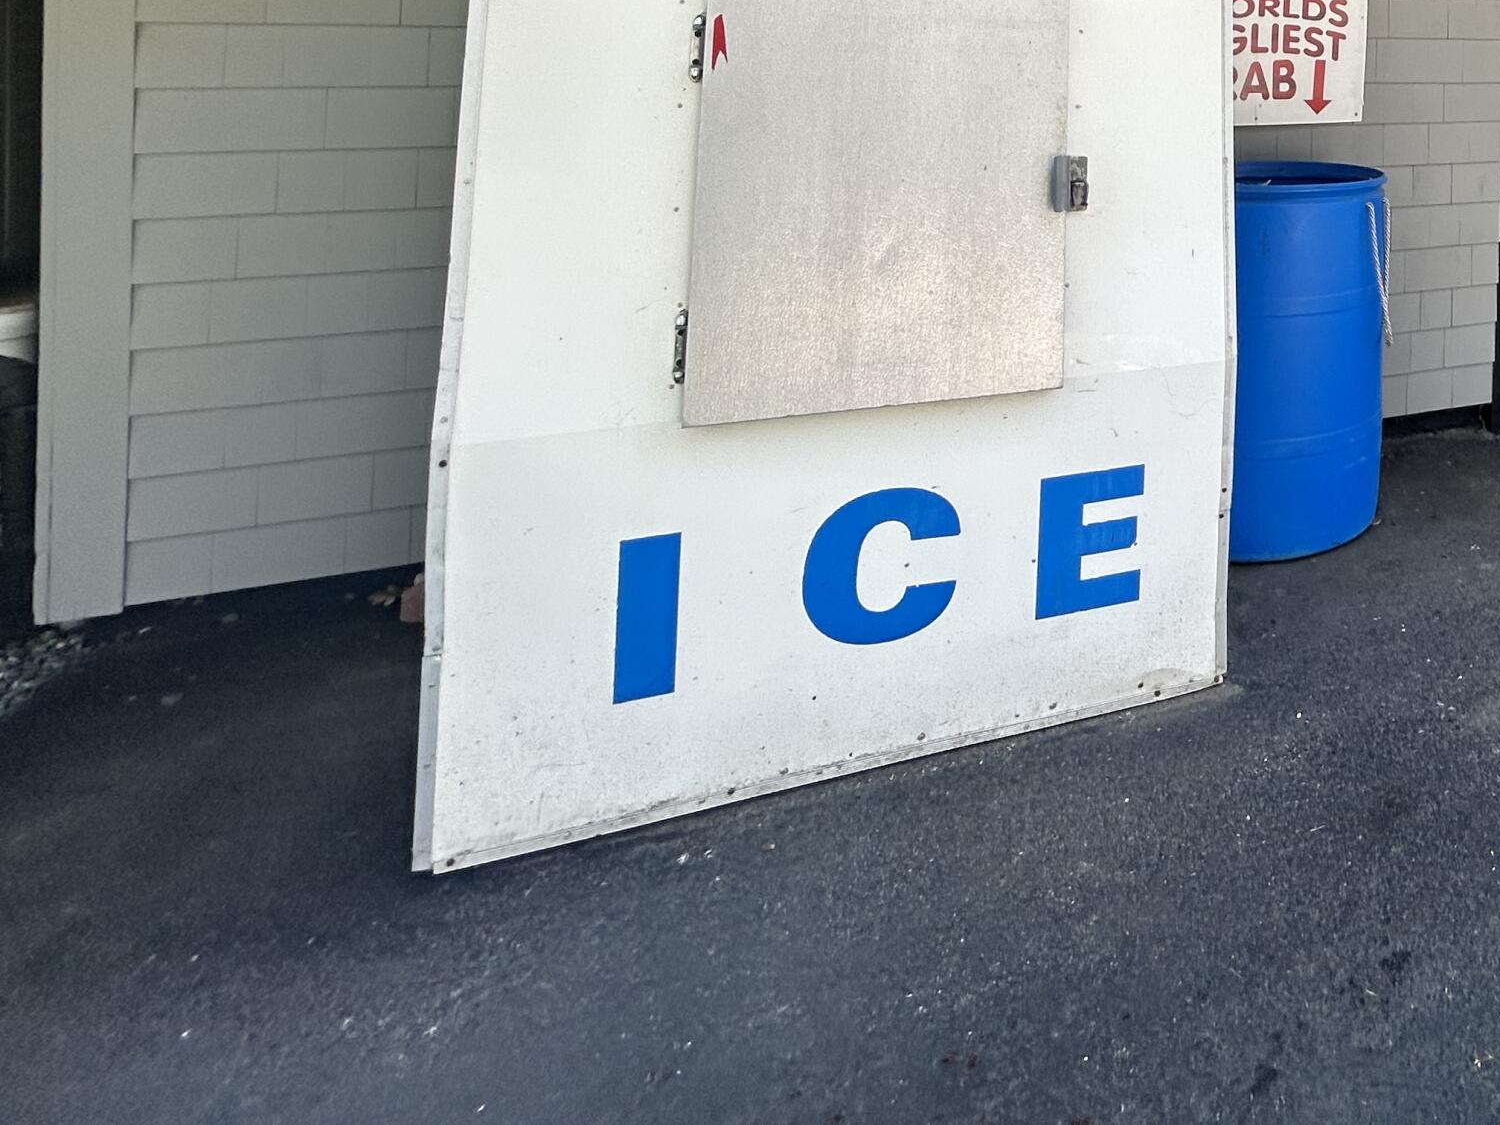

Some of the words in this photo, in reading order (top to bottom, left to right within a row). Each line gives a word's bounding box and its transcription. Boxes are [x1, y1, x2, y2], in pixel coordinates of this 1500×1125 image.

[1232, 22, 1347, 61] GLIEST
[1232, 59, 1298, 101] AB
[612, 462, 1146, 705] ICE
